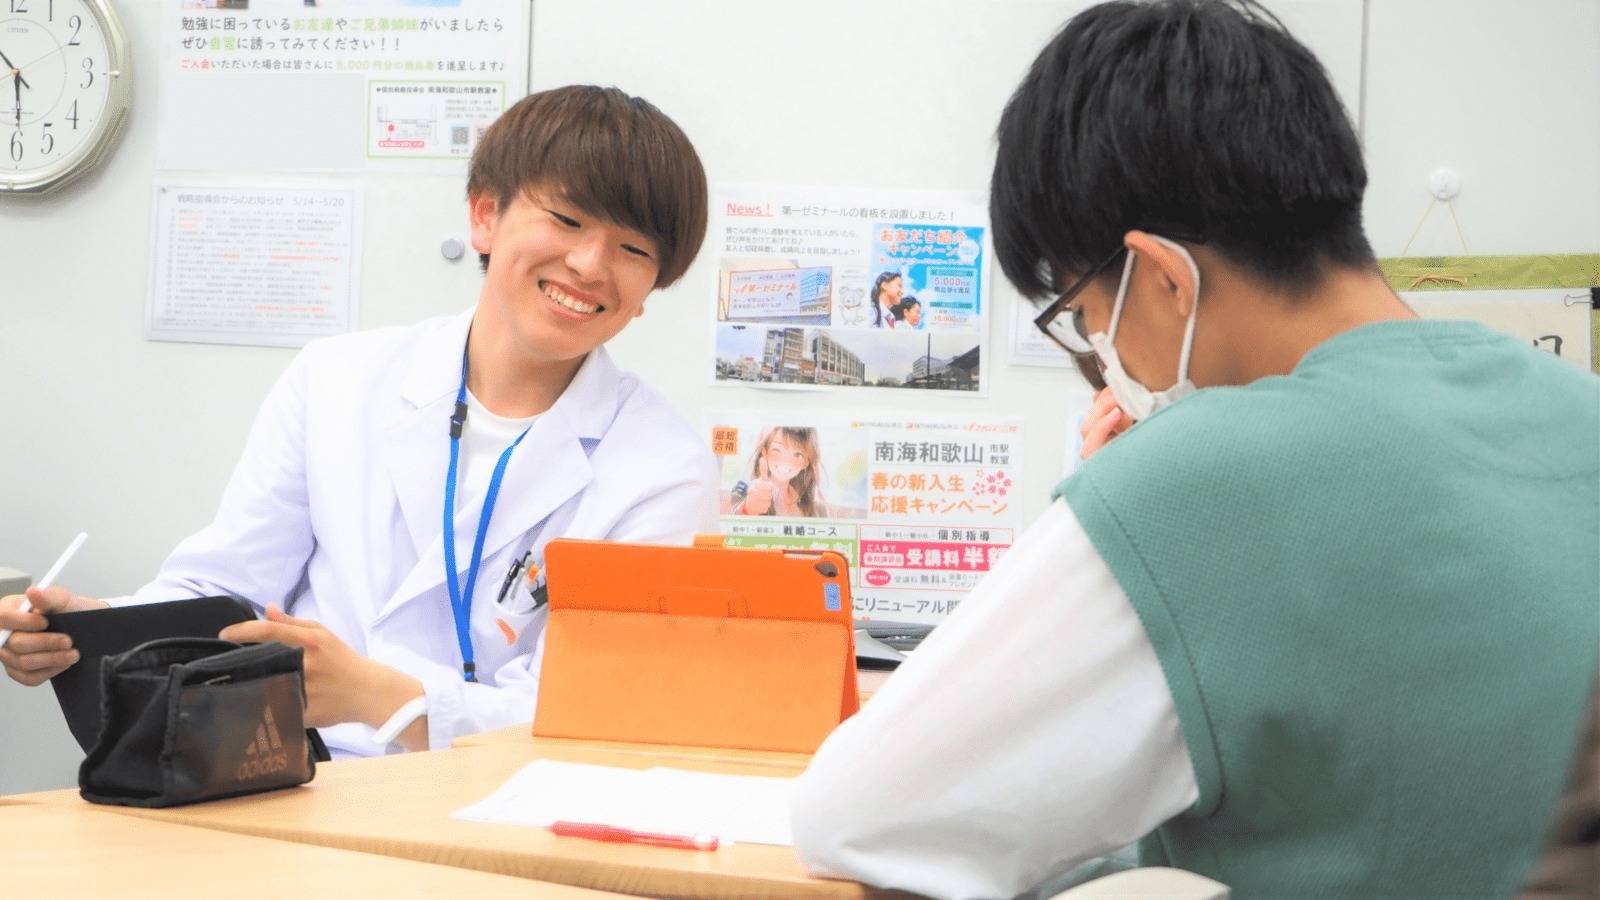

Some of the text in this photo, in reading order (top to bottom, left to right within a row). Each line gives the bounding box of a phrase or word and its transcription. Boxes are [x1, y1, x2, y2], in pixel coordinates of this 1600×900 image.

[68, 15, 82, 46] 2
[80, 57, 94, 90] 3
[65, 98, 80, 130] 4
[10, 129, 24, 162] 6
[40, 122, 54, 155] 5
[880, 228, 967, 245] お友だち紹介
[889, 243, 960, 258] キャンペーン
[874, 441, 1010, 465] 南海和歌山 市駅
[989, 454, 1010, 465] 教室
[870, 473, 966, 493] 春の新入生
[870, 494, 1009, 517] 応援キャンペーン
[783, 525, 838, 537] 戦略コース
[938, 529, 990, 542] 個別指導
[238, 752, 288, 780] adidas
